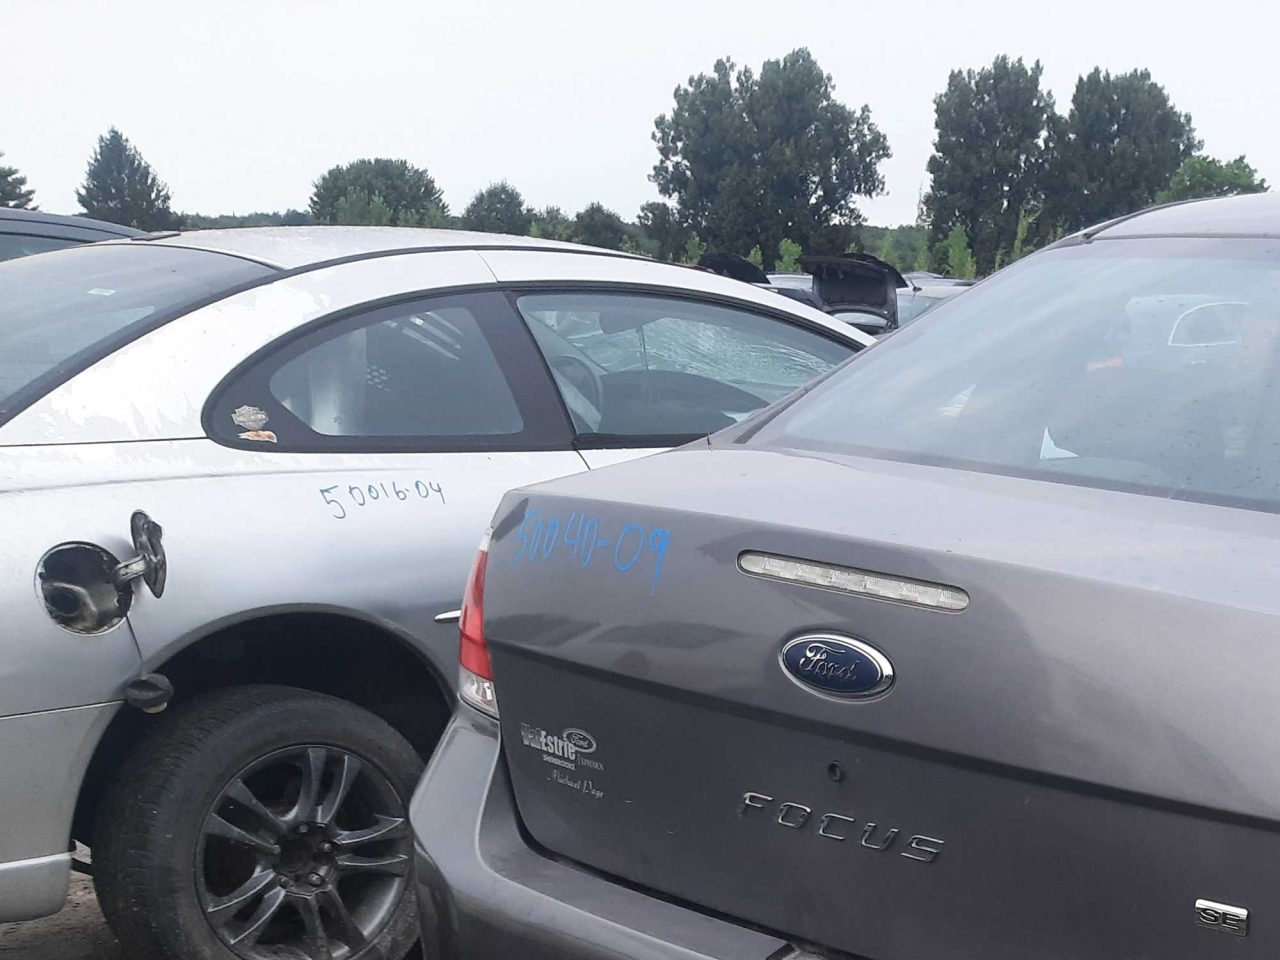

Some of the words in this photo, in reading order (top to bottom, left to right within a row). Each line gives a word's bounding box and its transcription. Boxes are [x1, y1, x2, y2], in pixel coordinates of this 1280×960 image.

[511, 508, 671, 594] 50040-09
[737, 792, 945, 863] FOCUS
[1199, 909, 1241, 930] SE
